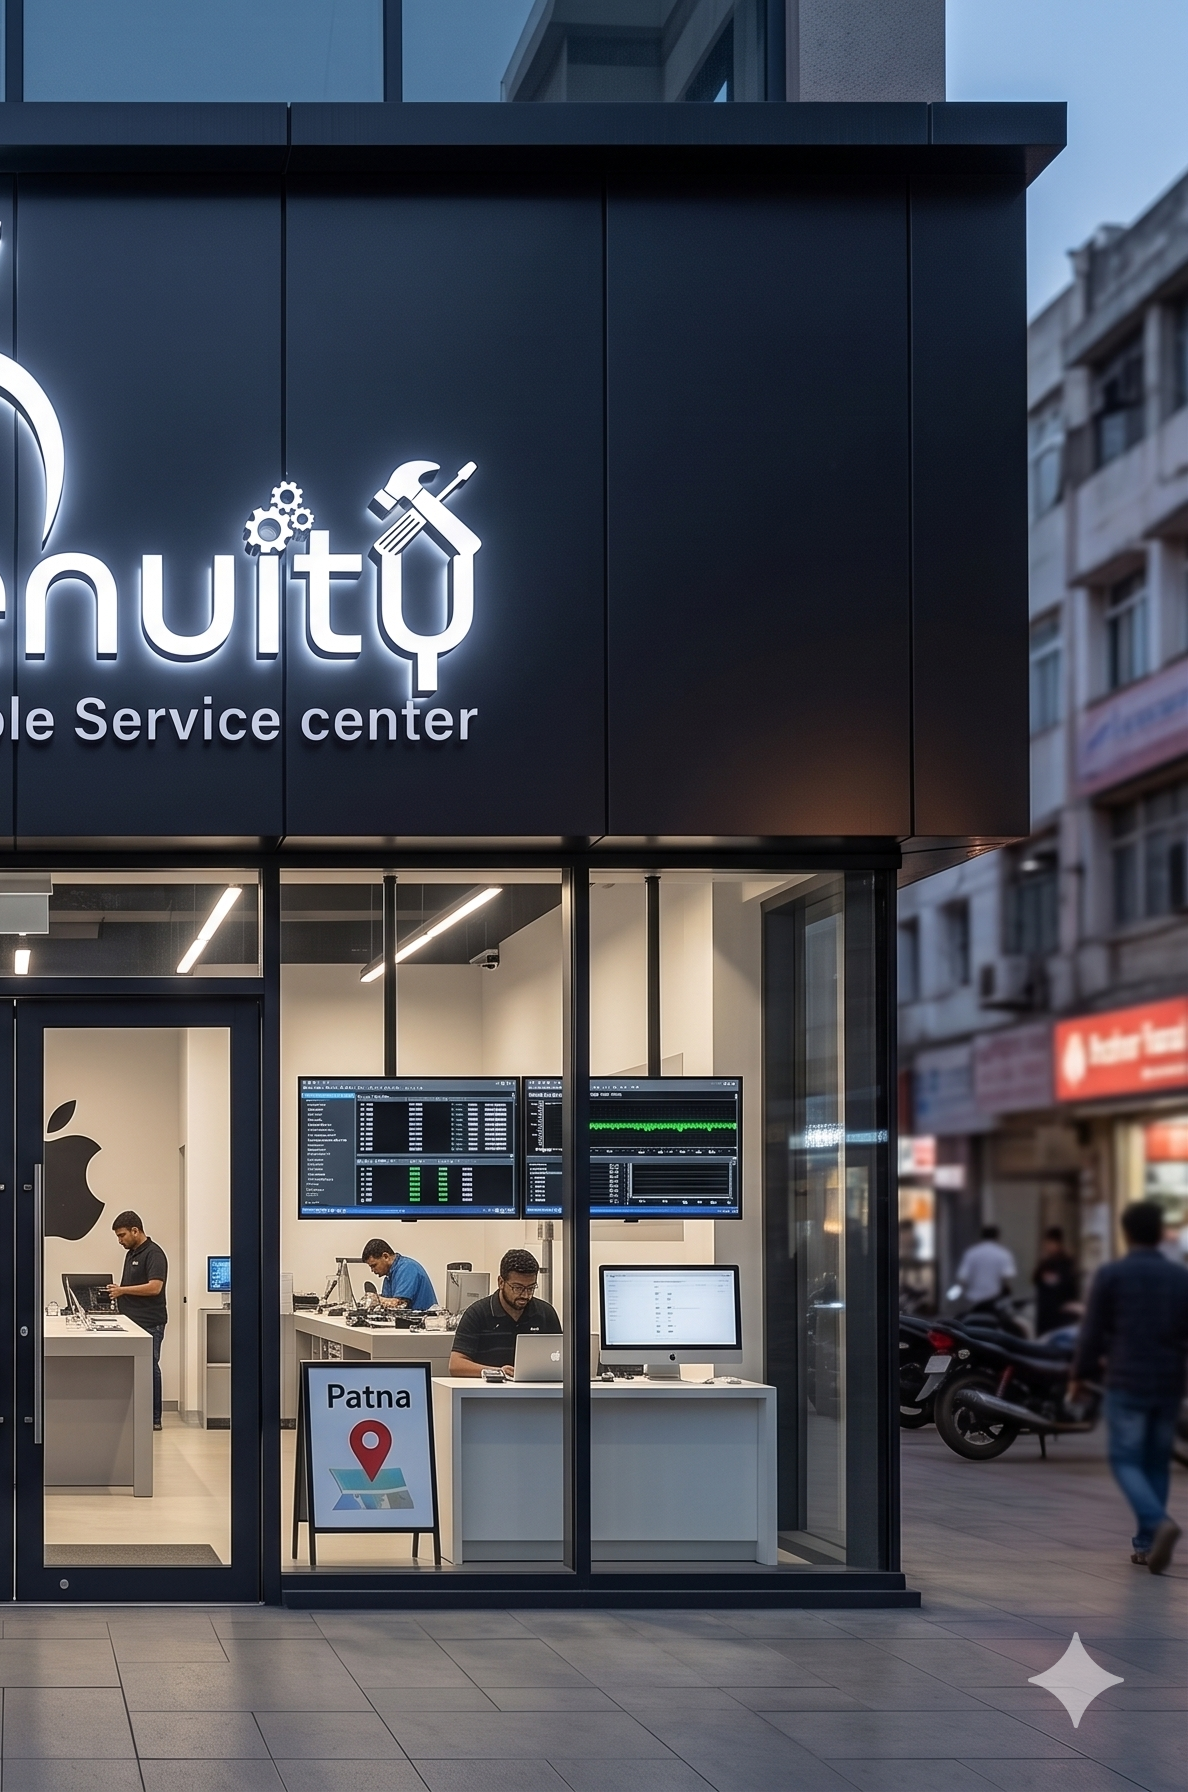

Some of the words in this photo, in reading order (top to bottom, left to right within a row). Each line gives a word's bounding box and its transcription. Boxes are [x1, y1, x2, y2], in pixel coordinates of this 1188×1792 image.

[74, 696, 281, 741] Service
[300, 698, 479, 741] center
[327, 1383, 411, 1409] Patna
